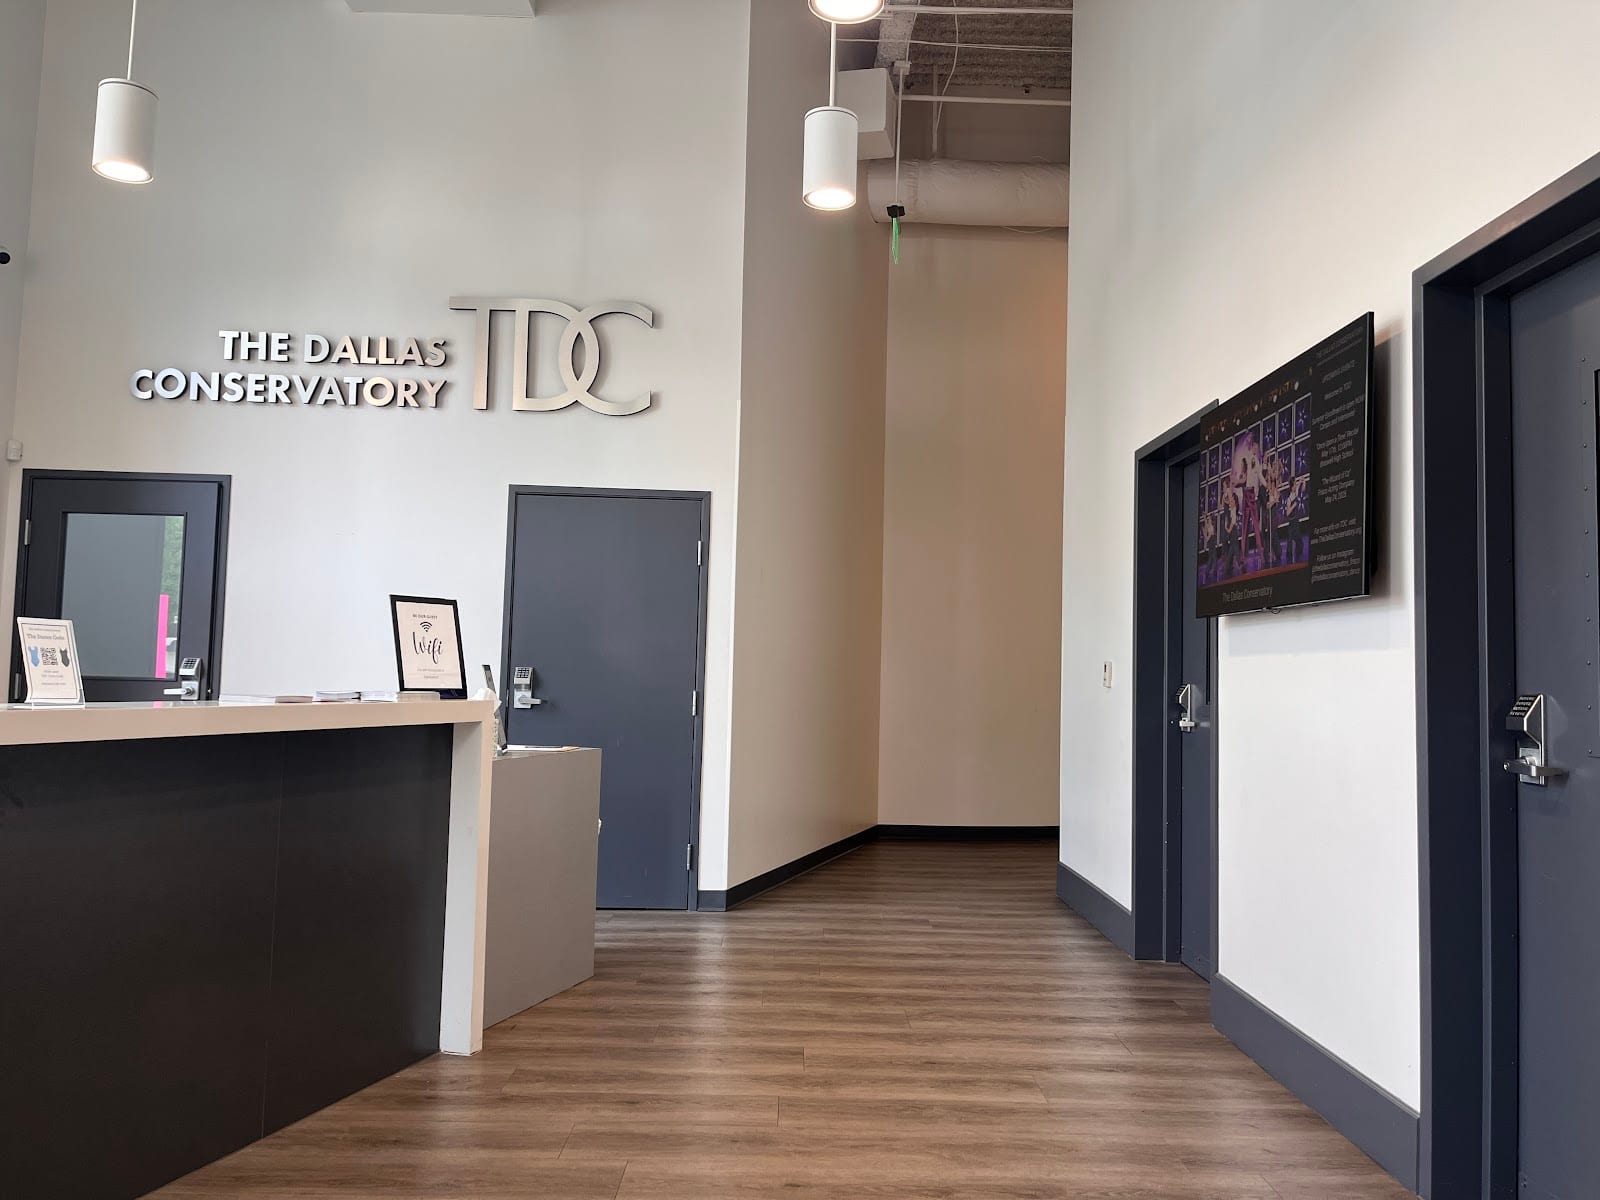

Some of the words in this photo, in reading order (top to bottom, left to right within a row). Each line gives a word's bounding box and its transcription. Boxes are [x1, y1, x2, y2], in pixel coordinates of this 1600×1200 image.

[219, 330, 291, 363] THE
[302, 334, 447, 368] DALLAS
[449, 296, 655, 416] TDC
[129, 367, 448, 409] CONSERVATORY
[1231, 589, 1244, 601] Dallas
[1244, 585, 1273, 599] Conservatory
[412, 631, 443, 665] Wifi
